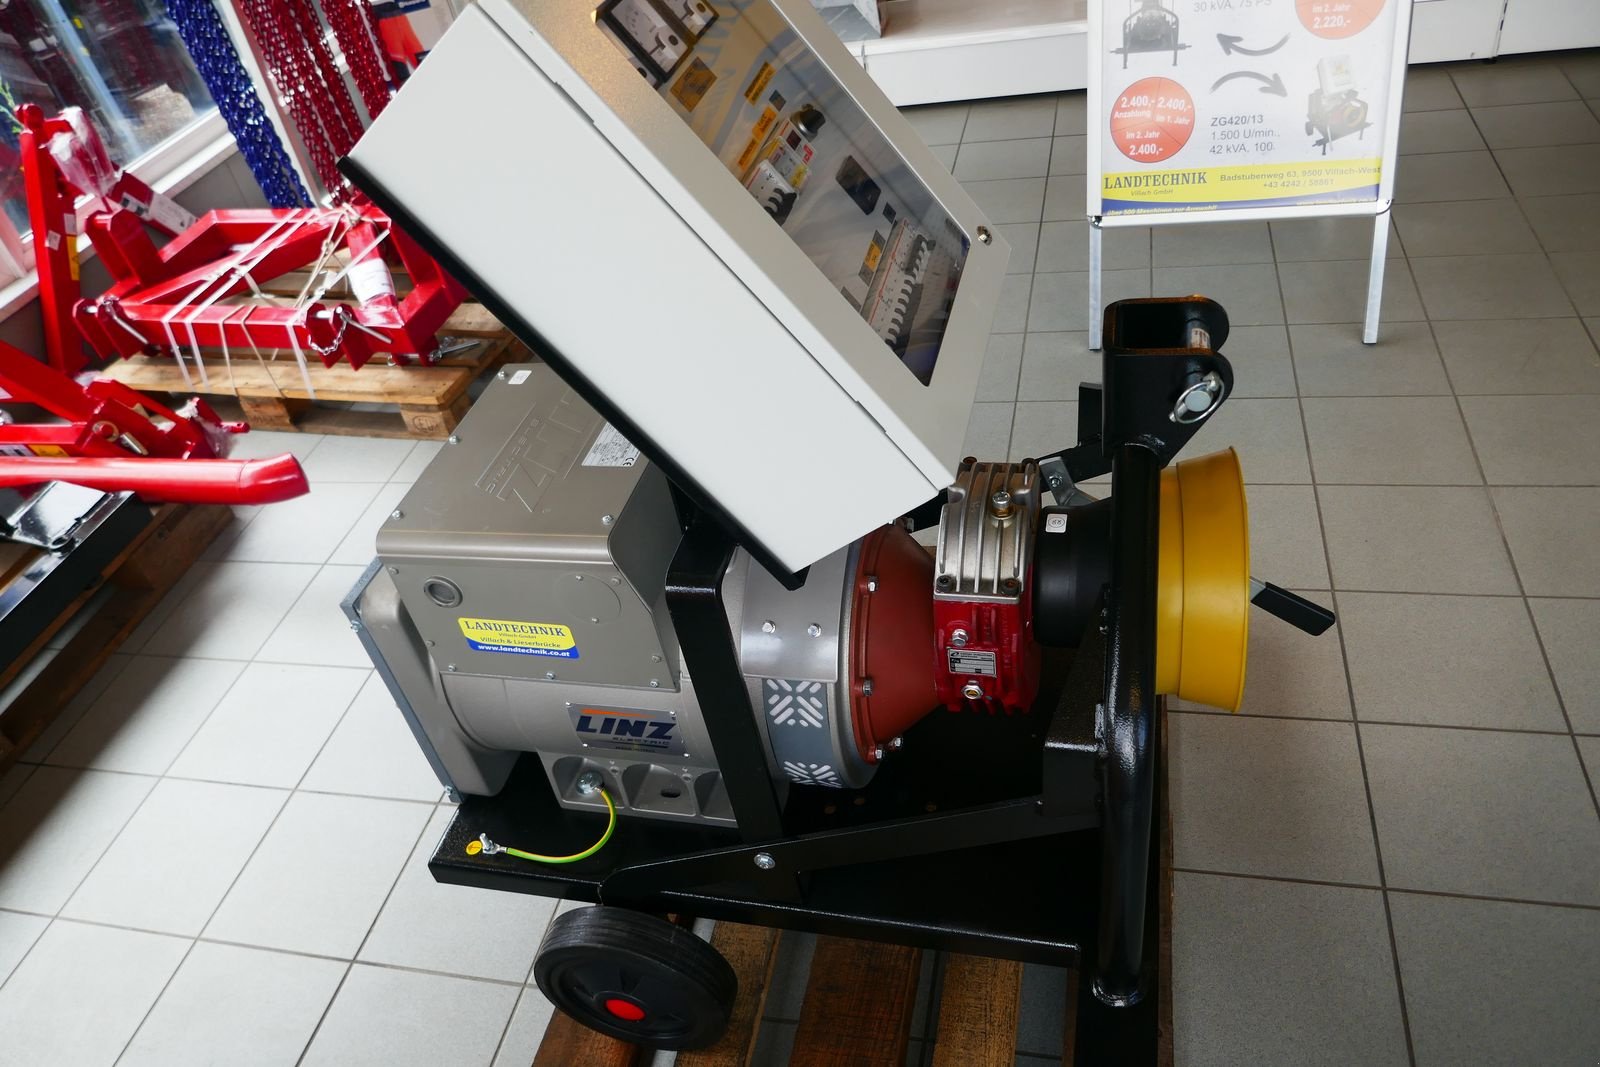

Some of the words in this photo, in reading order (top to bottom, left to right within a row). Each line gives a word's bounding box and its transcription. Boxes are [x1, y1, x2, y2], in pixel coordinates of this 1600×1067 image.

[1193, 2, 1207, 12] 30
[1312, 16, 1351, 29] 2.220,-
[1121, 96, 1155, 108] 2.400,-
[1157, 97, 1192, 112] 2.400,-
[1210, 114, 1264, 127] ZG420/13
[1144, 130, 1161, 139] Jahr
[1212, 130, 1240, 141] 1.500
[1129, 144, 1163, 156] 2.400,-
[1209, 144, 1223, 154] 42
[1104, 171, 1207, 189] LANDTECHNIK
[1220, 171, 1284, 182] Badstubenweg
[1302, 169, 1322, 177] 9500
[1279, 180, 1301, 188] 4242
[464, 621, 566, 637] LANDTECHNIK
[480, 636, 506, 644] Villach
[513, 639, 561, 648] Lieserbrücke
[478, 644, 570, 657] www.landtechnik.co.at
[576, 715, 677, 740] LINZ
